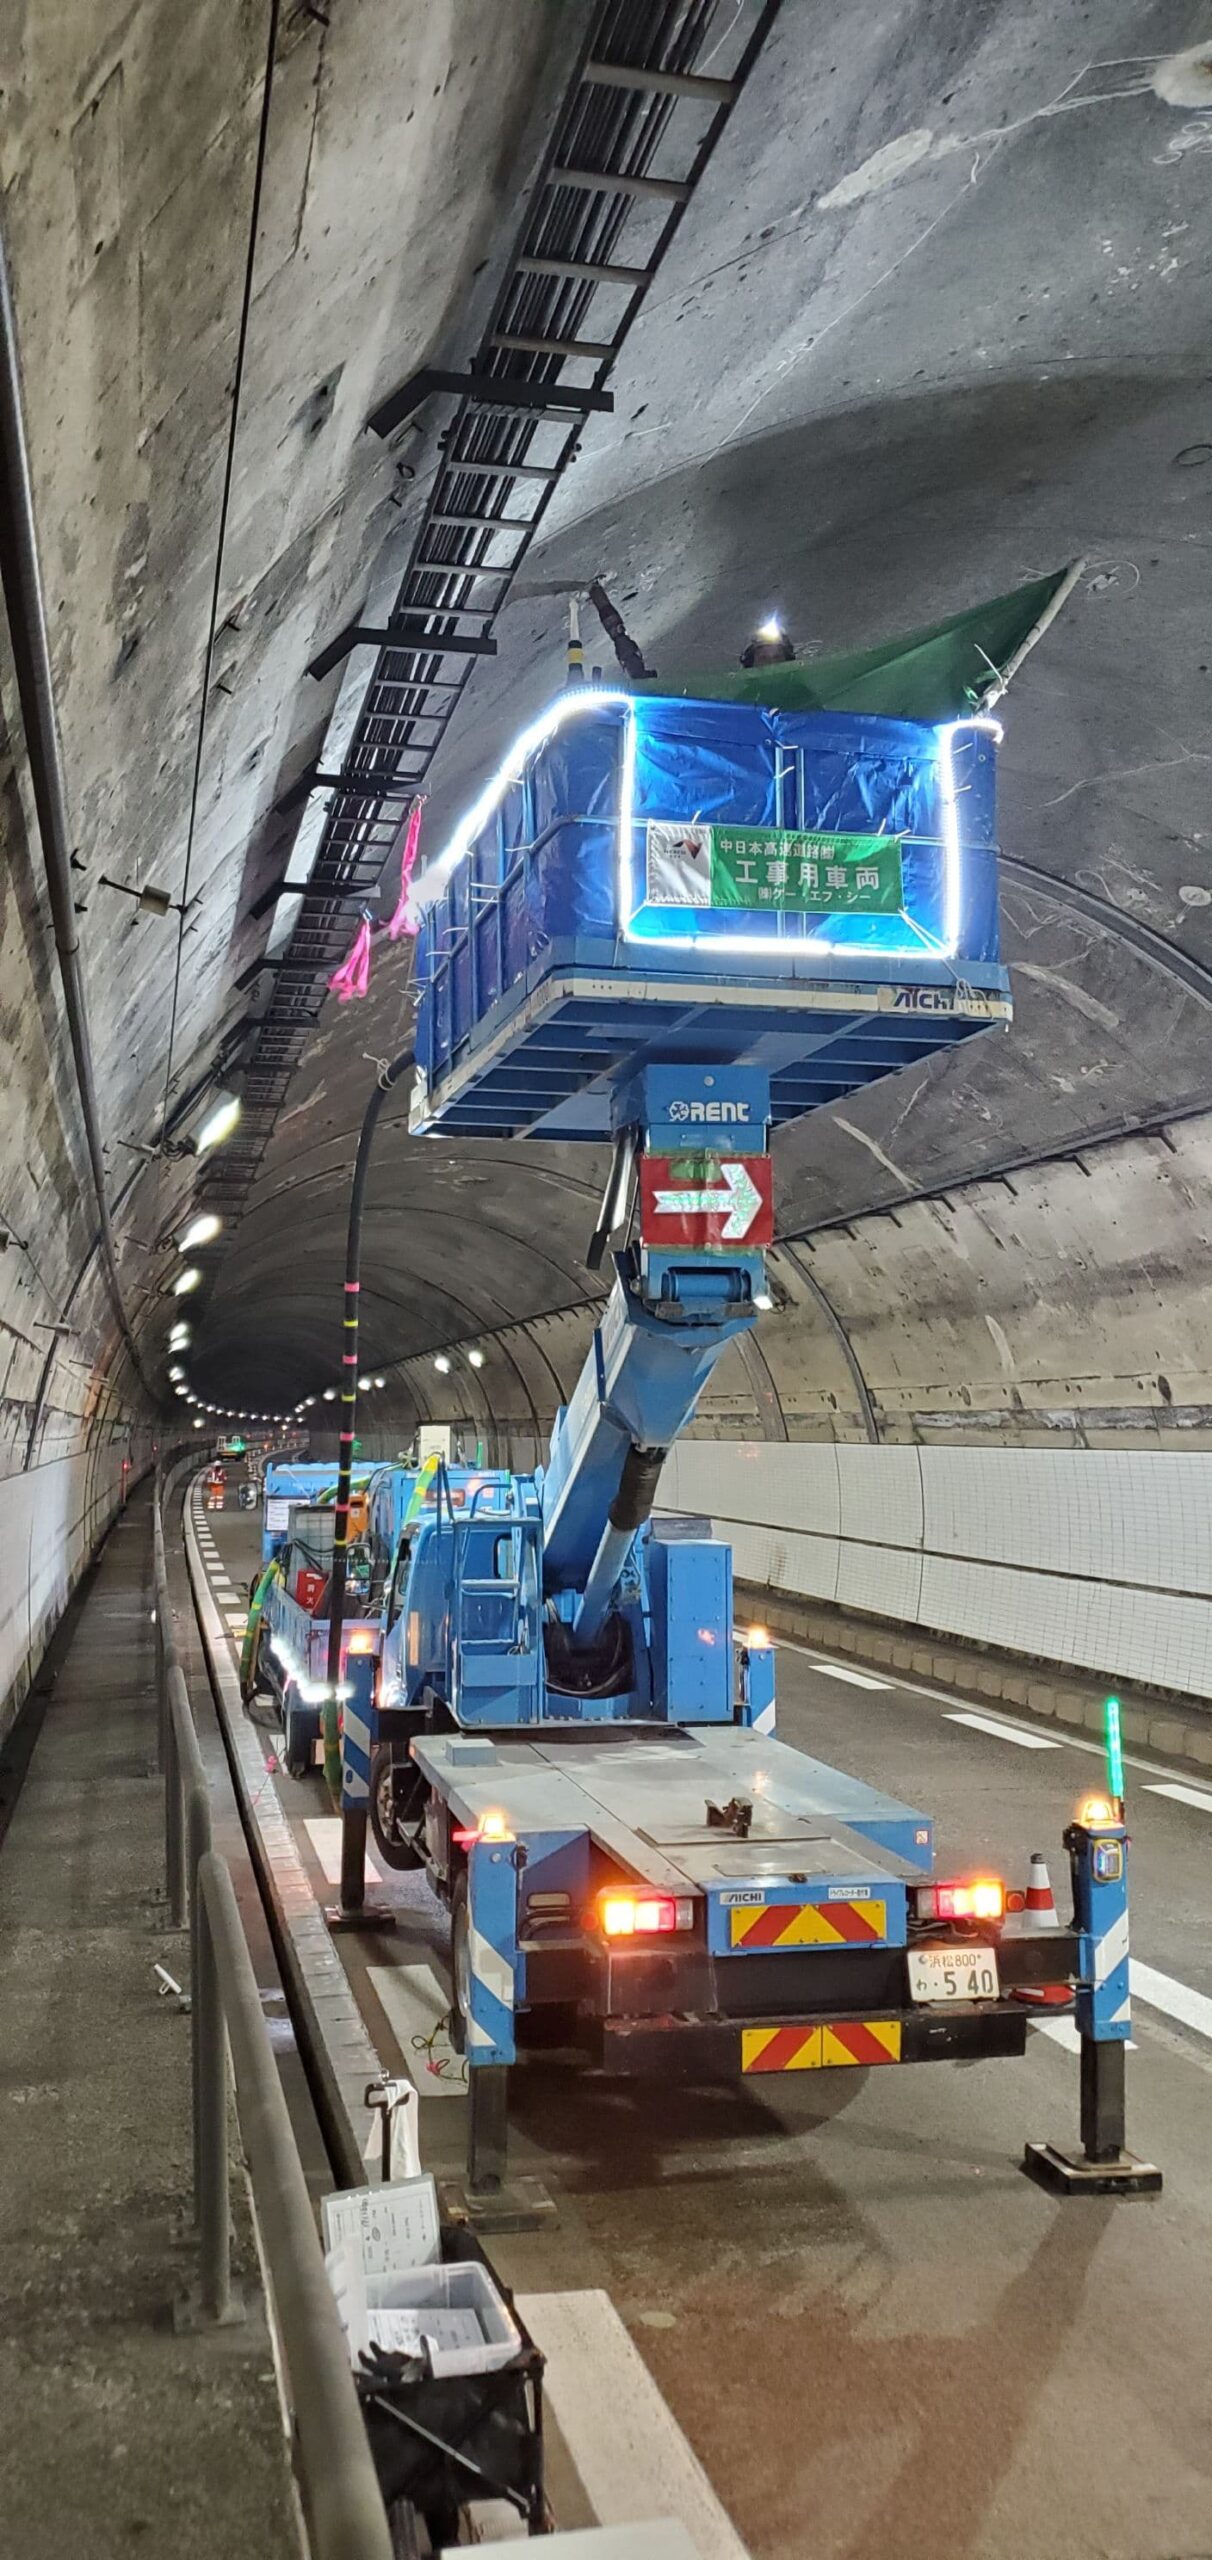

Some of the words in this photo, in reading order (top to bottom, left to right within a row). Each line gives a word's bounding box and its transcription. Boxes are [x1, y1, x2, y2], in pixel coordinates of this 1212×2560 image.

[735, 860, 880, 890] 工事用車両
[728, 1892, 762, 1903] AICHI
